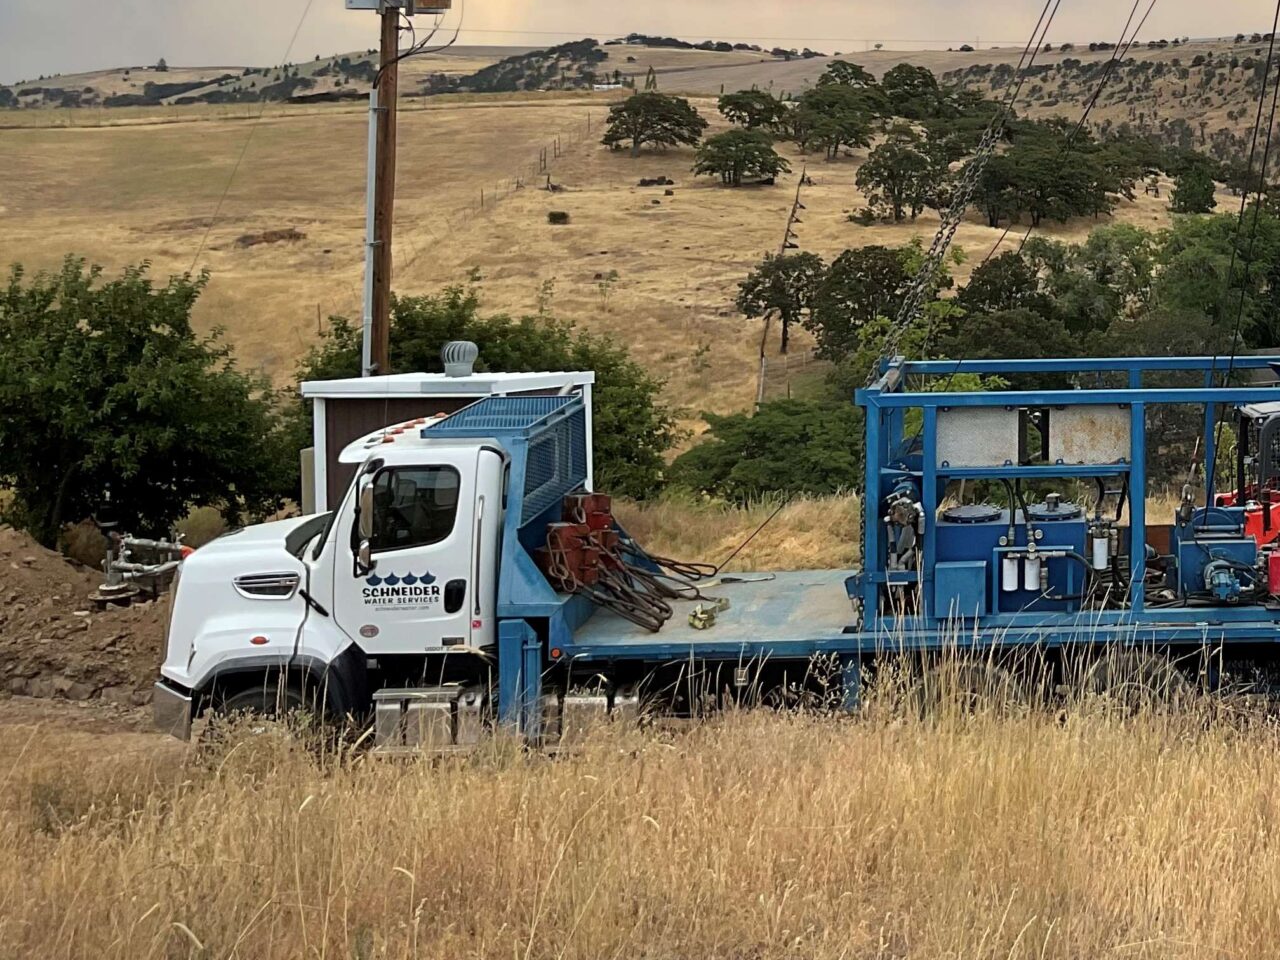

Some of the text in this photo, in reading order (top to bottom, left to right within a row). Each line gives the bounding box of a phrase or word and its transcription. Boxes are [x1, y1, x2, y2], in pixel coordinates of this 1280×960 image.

[362, 585, 441, 598] SCHNEIDER
[364, 596, 439, 605] WATER SERVICES
